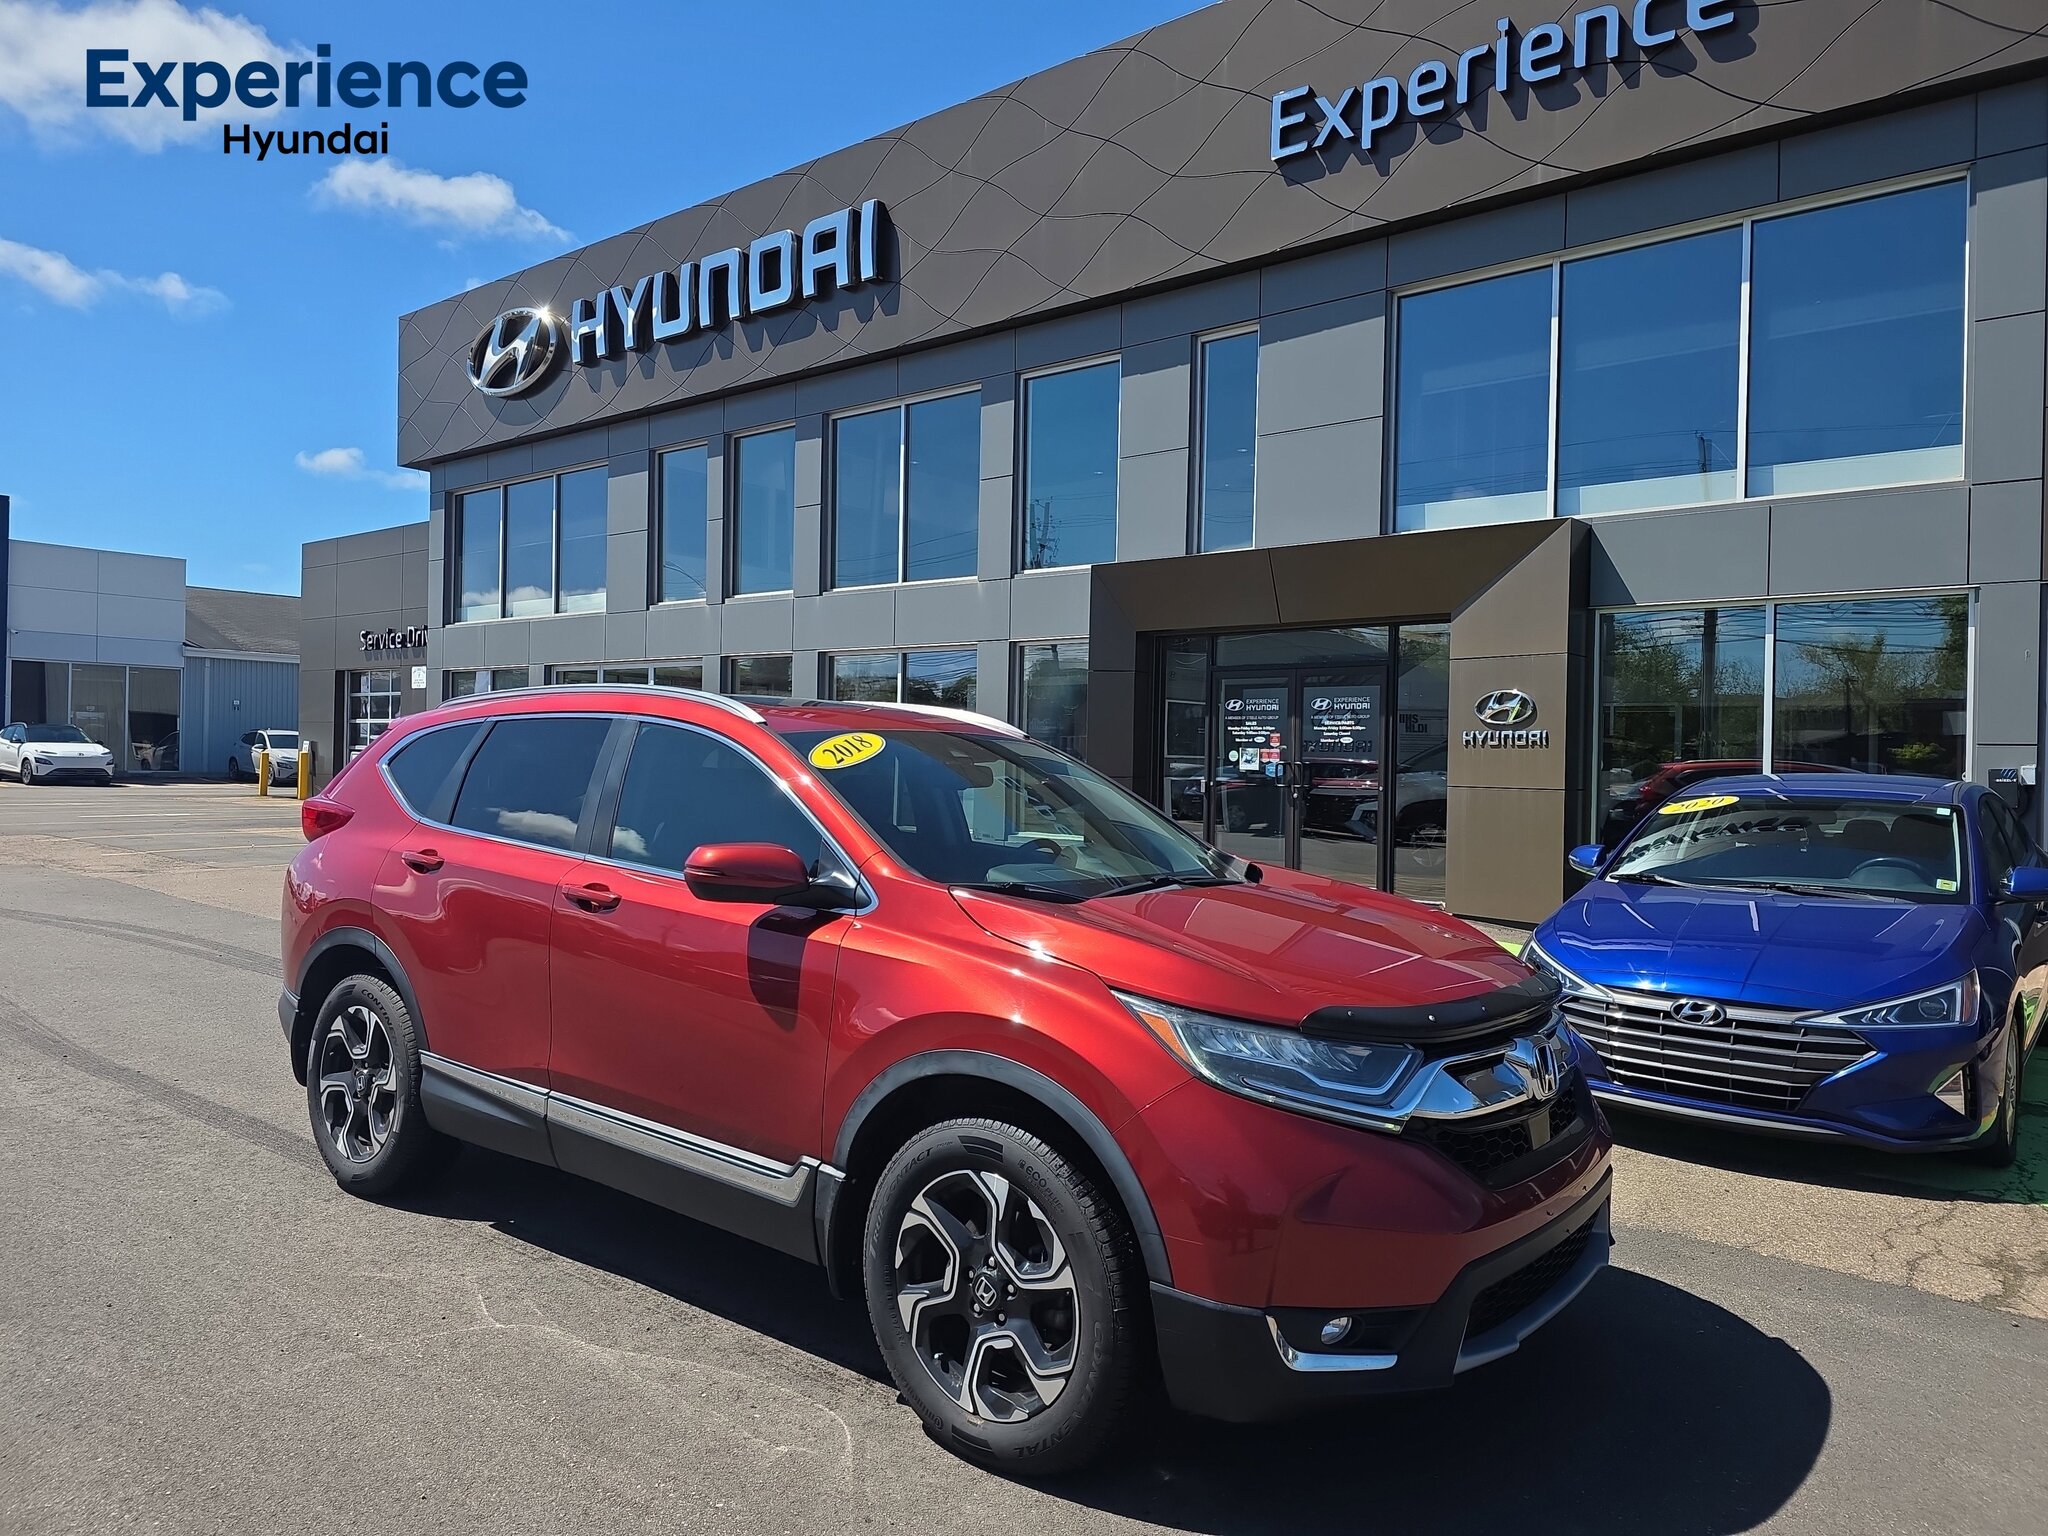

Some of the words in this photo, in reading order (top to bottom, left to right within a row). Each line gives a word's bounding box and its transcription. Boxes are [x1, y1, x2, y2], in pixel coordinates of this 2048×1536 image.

[571, 198, 881, 365] HYUNDAI
[360, 628, 403, 651] Service
[822, 735, 874, 764] 2018
[1462, 730, 1549, 749] HYUNDAI
[1672, 798, 1725, 812] 2020
